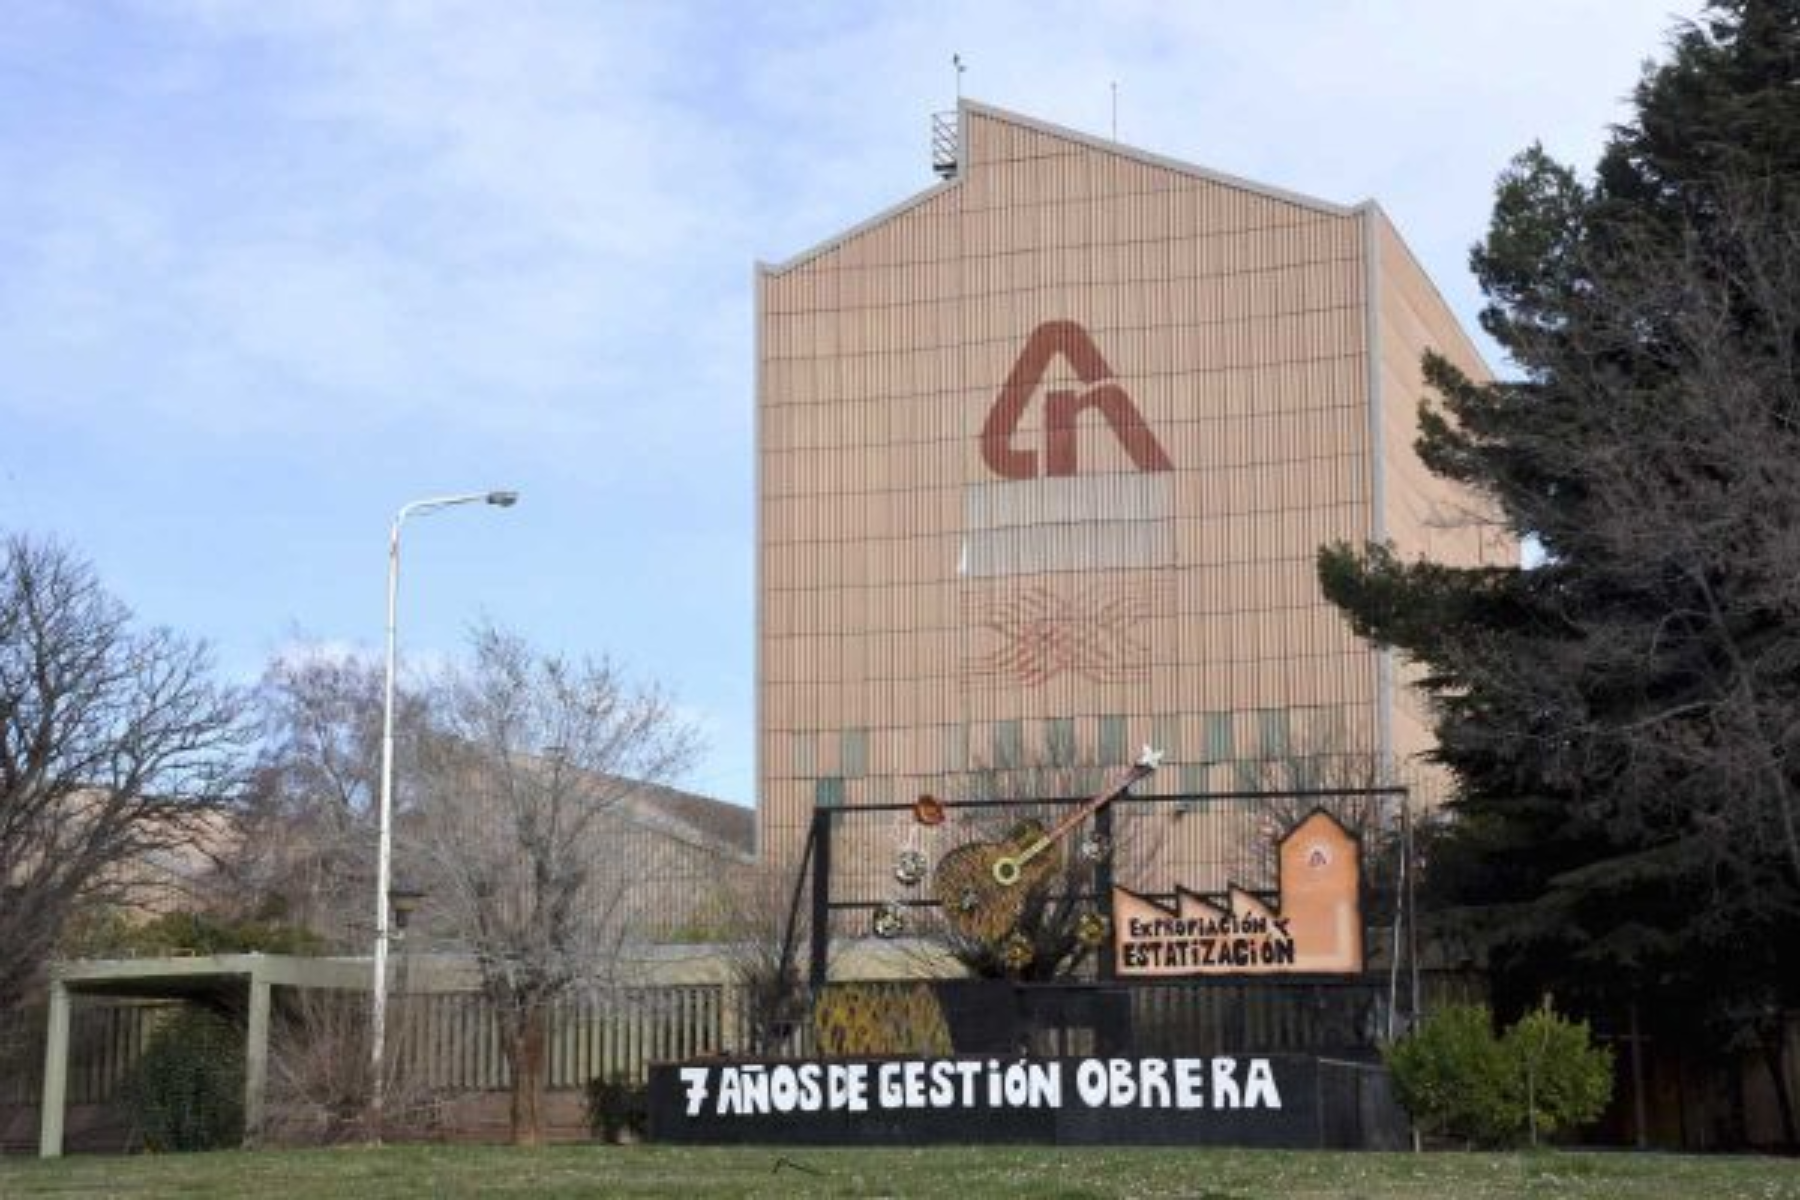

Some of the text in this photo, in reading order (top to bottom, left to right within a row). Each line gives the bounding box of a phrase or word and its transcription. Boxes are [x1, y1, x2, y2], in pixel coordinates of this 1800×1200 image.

[680, 1067, 709, 1115] 7
[717, 1064, 821, 1115] AÑOS
[828, 1064, 867, 1111] DE
[1076, 1057, 1282, 1109] OBRERA
